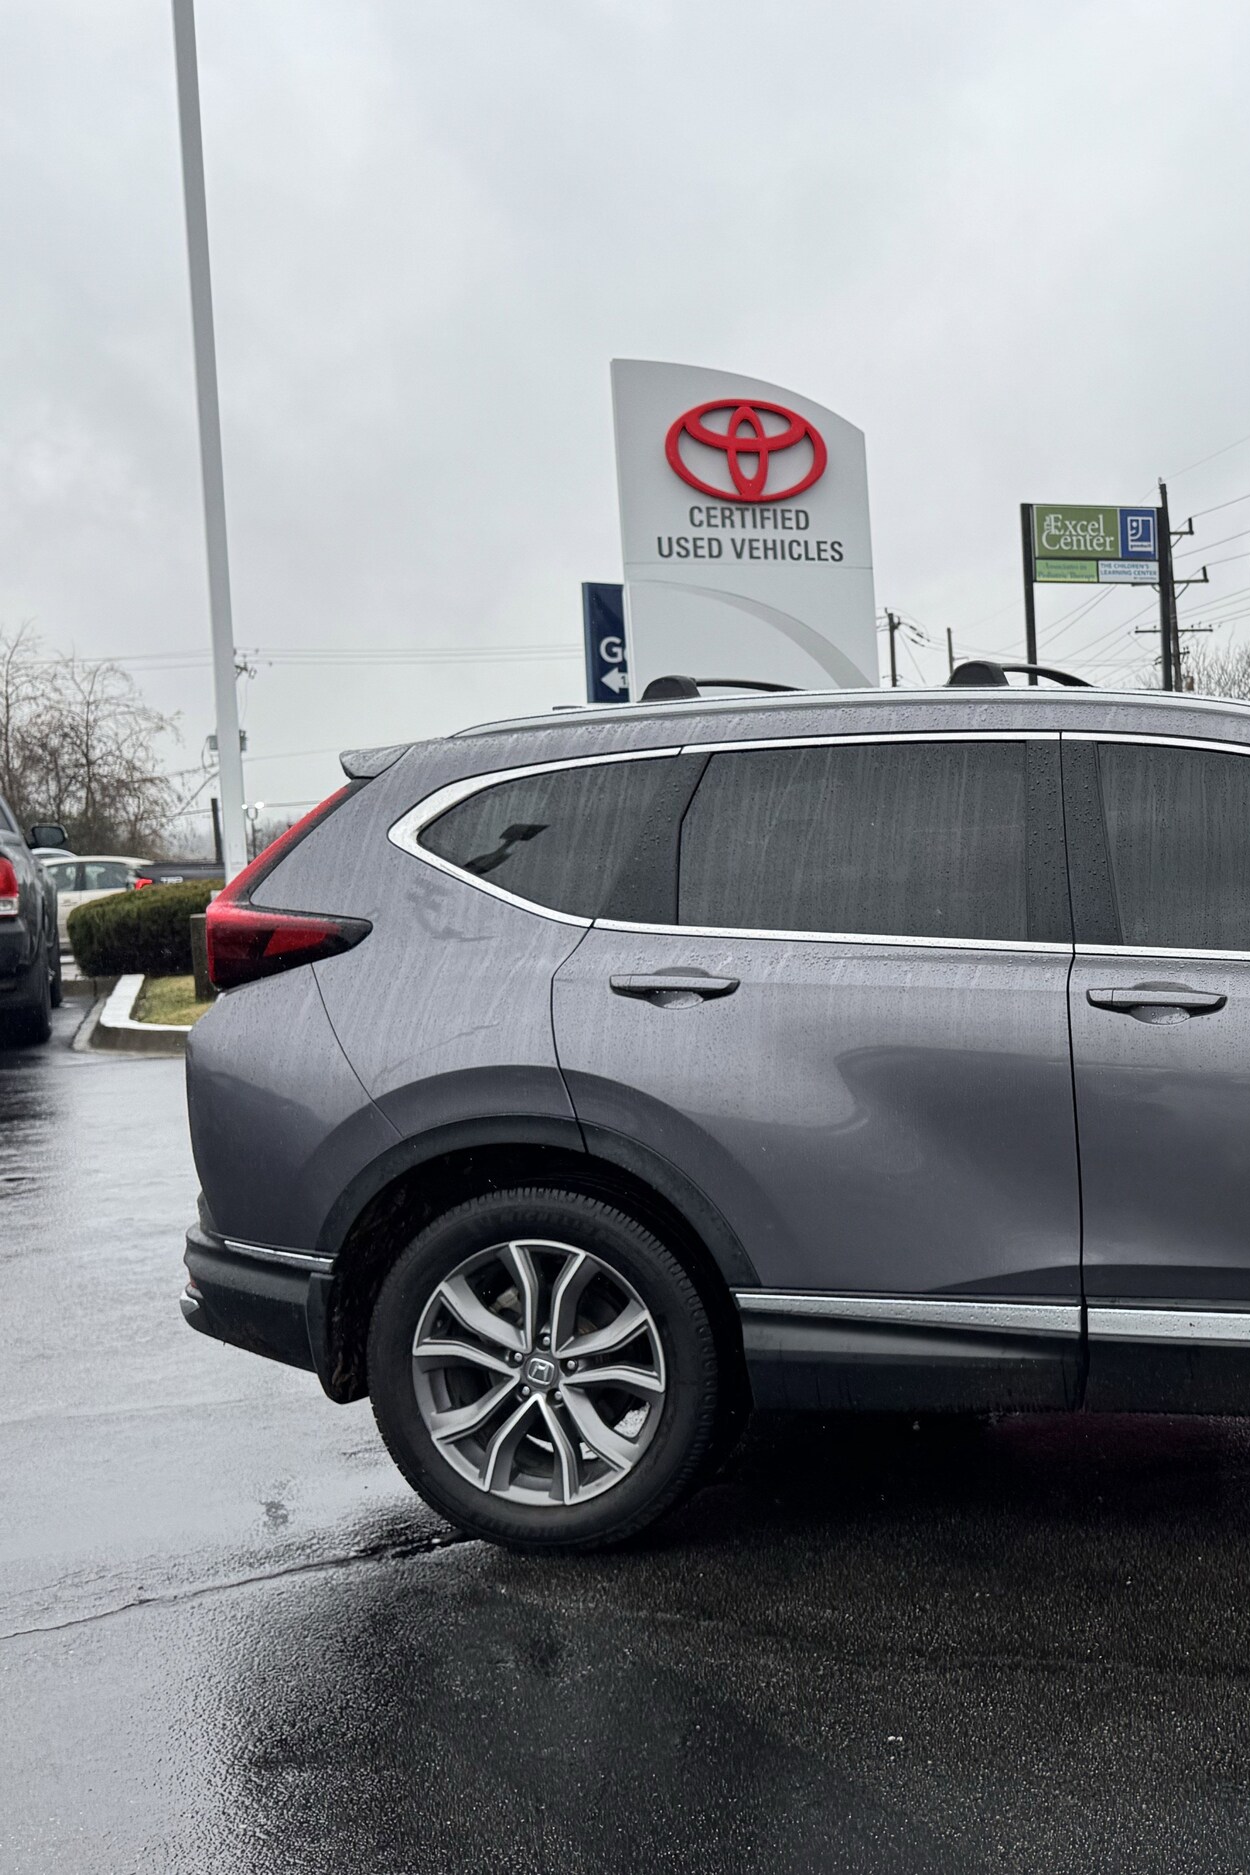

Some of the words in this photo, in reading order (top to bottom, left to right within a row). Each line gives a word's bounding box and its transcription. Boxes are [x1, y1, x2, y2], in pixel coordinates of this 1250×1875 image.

[688, 505, 811, 531] CERTIFIED
[1049, 513, 1105, 536] Excel
[656, 536, 723, 559] USED
[730, 537, 845, 563] VEHICLES
[1041, 530, 1115, 552] Center
[599, 635, 627, 664] G
